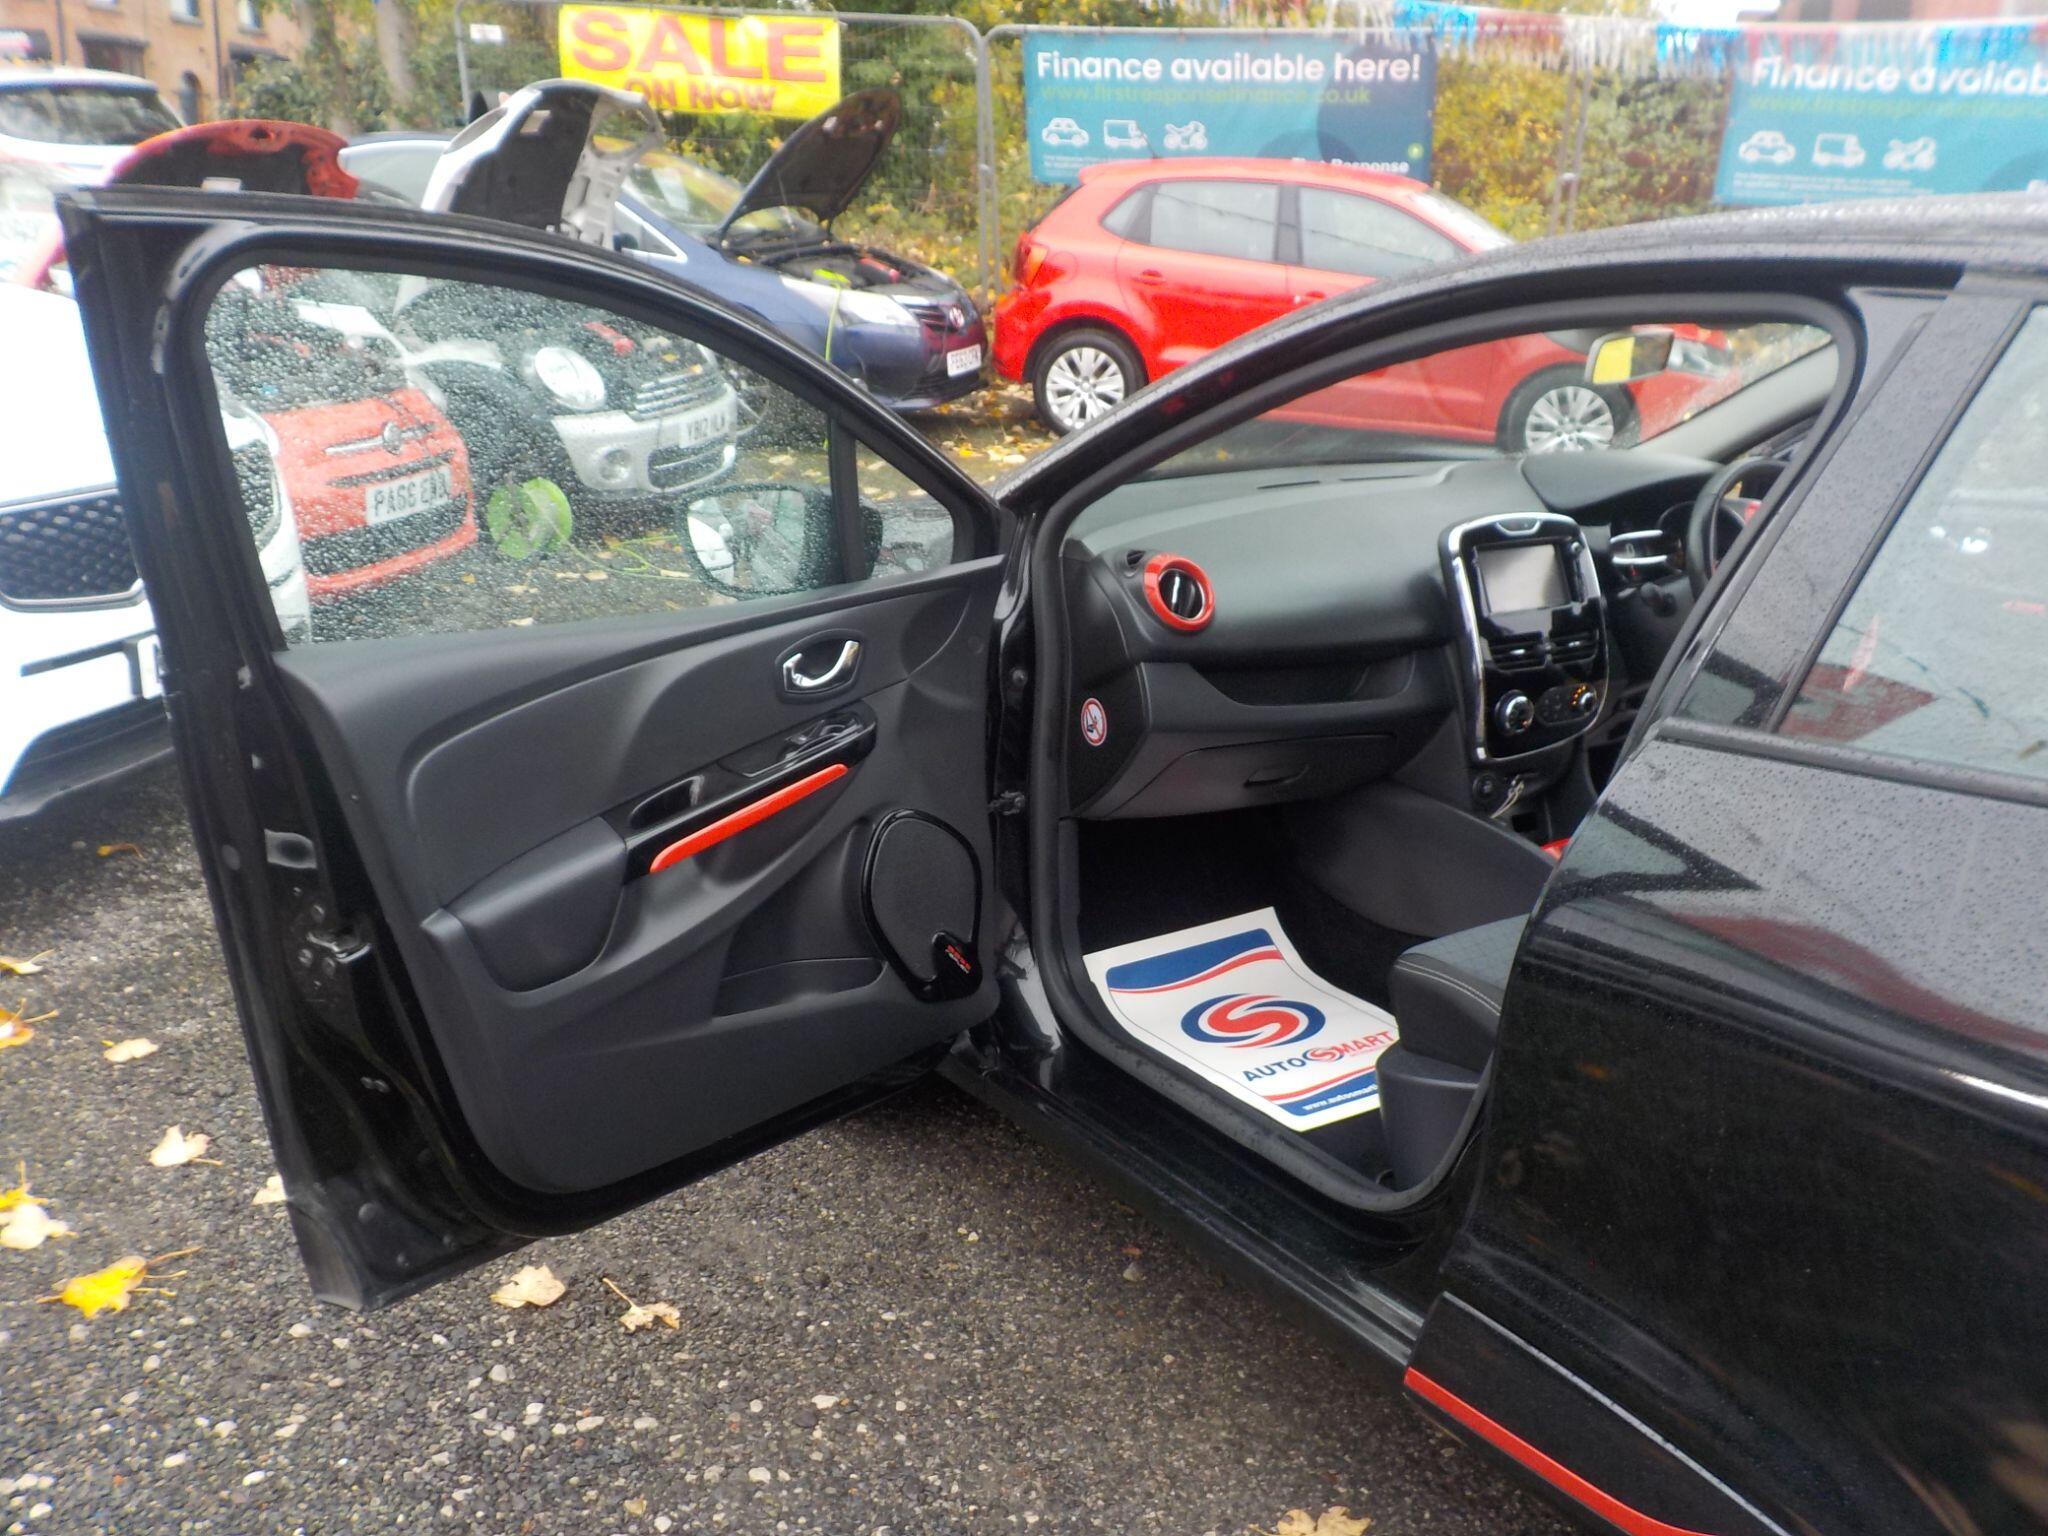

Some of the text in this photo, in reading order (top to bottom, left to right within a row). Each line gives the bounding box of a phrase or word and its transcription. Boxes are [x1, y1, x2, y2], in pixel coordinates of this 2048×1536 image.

[573, 10, 826, 82] SALE
[1037, 51, 1421, 82] Finance available here!
[1751, 55, 1900, 92] Finance
[625, 78, 776, 111] ON NOW
